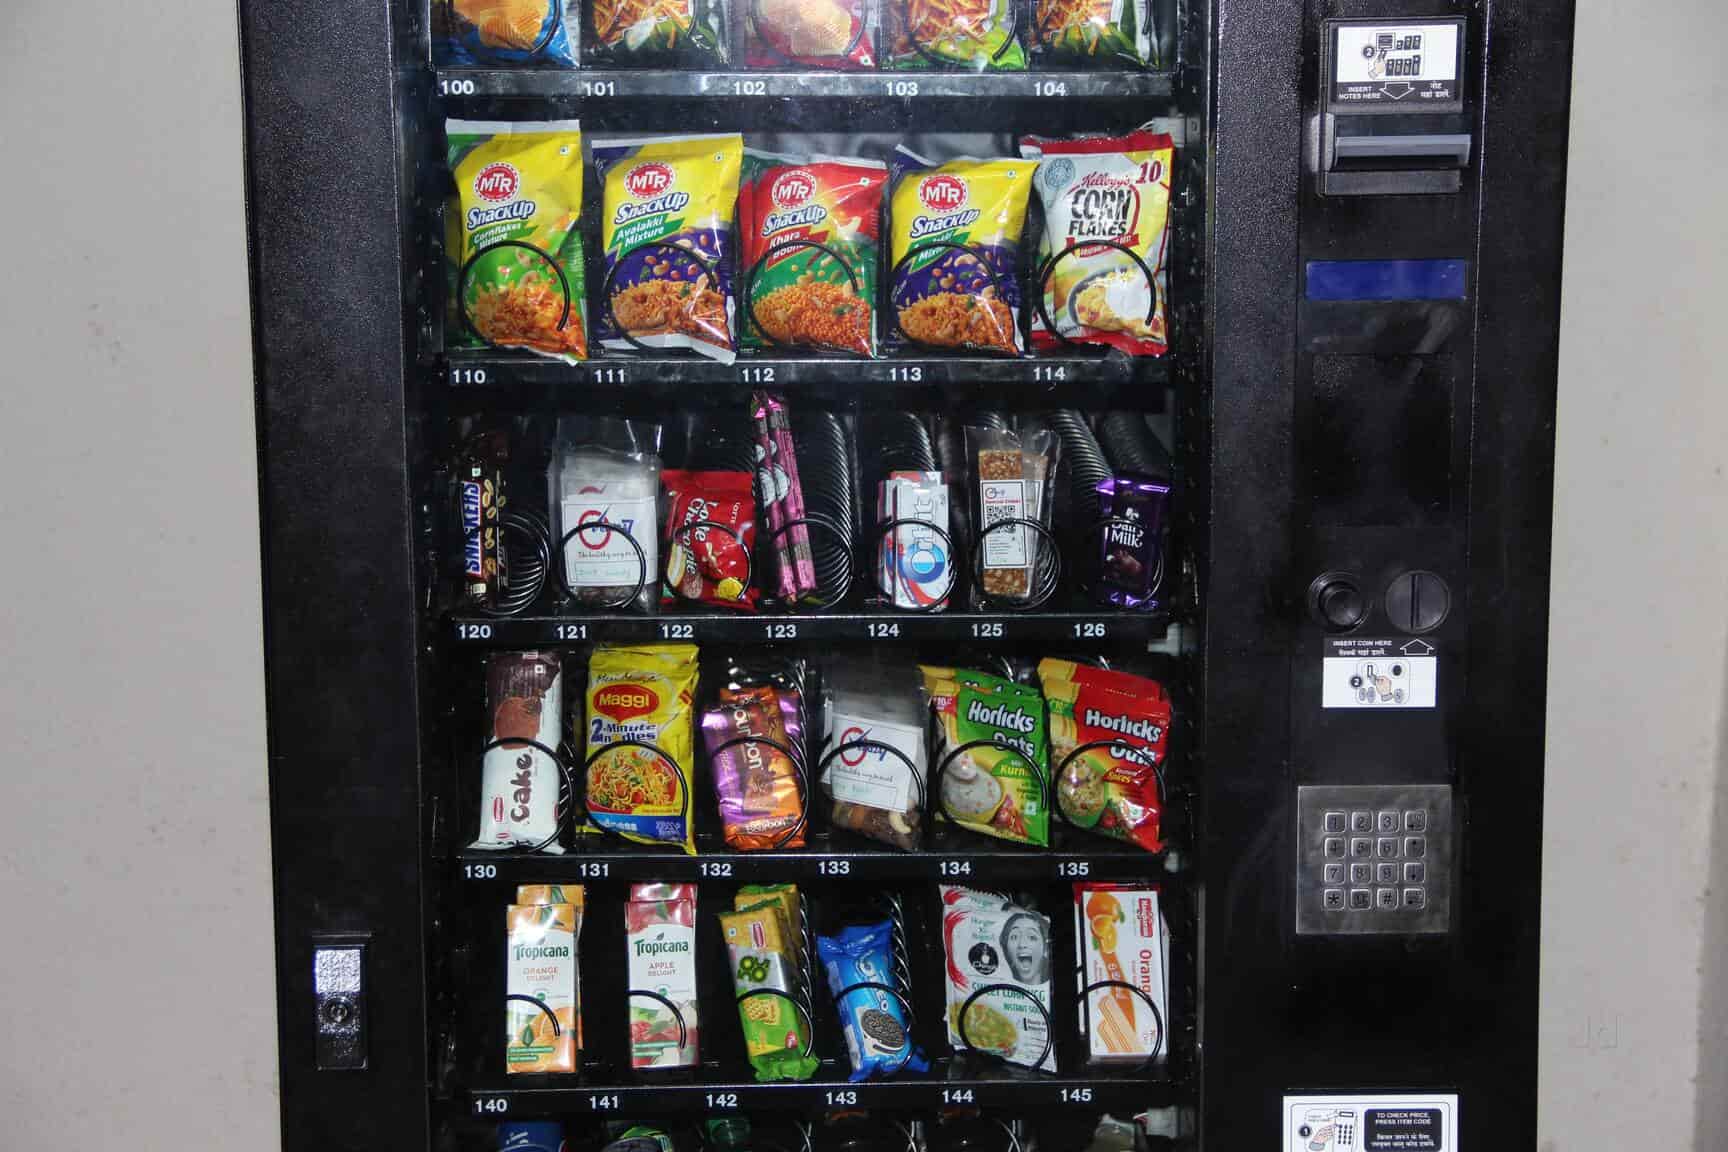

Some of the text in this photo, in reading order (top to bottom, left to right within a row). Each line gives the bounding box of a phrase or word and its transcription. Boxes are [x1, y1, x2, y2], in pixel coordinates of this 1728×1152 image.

[442, 80, 474, 94] 100
[584, 82, 615, 96] 101
[734, 81, 765, 95] 102
[887, 80, 918, 96] 103
[1035, 82, 1065, 96] 104
[1135, 160, 1162, 185] 10
[480, 172, 511, 193] MTR
[631, 170, 666, 189] MTR
[778, 181, 809, 201] MTR
[925, 182, 961, 203] MTR
[1071, 190, 1132, 221] CORN
[1068, 220, 1127, 237] FLAKES
[625, 226, 665, 248] Mixture
[769, 231, 801, 250] Khara
[454, 370, 485, 383] 110
[596, 369, 624, 382] 111
[743, 368, 774, 381] 112
[890, 368, 921, 381] 113
[1035, 367, 1065, 380] 114
[1111, 529, 1143, 548] Milk
[460, 625, 490, 638] 120
[558, 626, 585, 638] 121
[663, 625, 693, 637] 122
[767, 625, 796, 637] 123
[869, 624, 899, 636] 124
[973, 624, 1002, 636] 125
[1075, 624, 1104, 636] 126
[968, 701, 1034, 734] Horlicks
[1086, 709, 1161, 743] Horlicks
[466, 865, 496, 878] 130
[581, 864, 608, 876] 131
[702, 863, 731, 876] 132
[820, 861, 849, 874] 133
[941, 862, 970, 874] 134
[1059, 863, 1088, 875] 135
[514, 944, 569, 961] Tropicana
[633, 939, 689, 957] Tropicana
[523, 967, 558, 975] ORANGE
[649, 961, 674, 969] APPLE
[648, 969, 675, 977] DELIGHT
[1137, 949, 1153, 998] Orang
[707, 1094, 736, 1106] 142
[827, 1092, 856, 1104] 143
[944, 1090, 972, 1102] 144
[1062, 1089, 1091, 1101] 145
[476, 1099, 507, 1112] 140
[591, 1096, 617, 1108] 141
